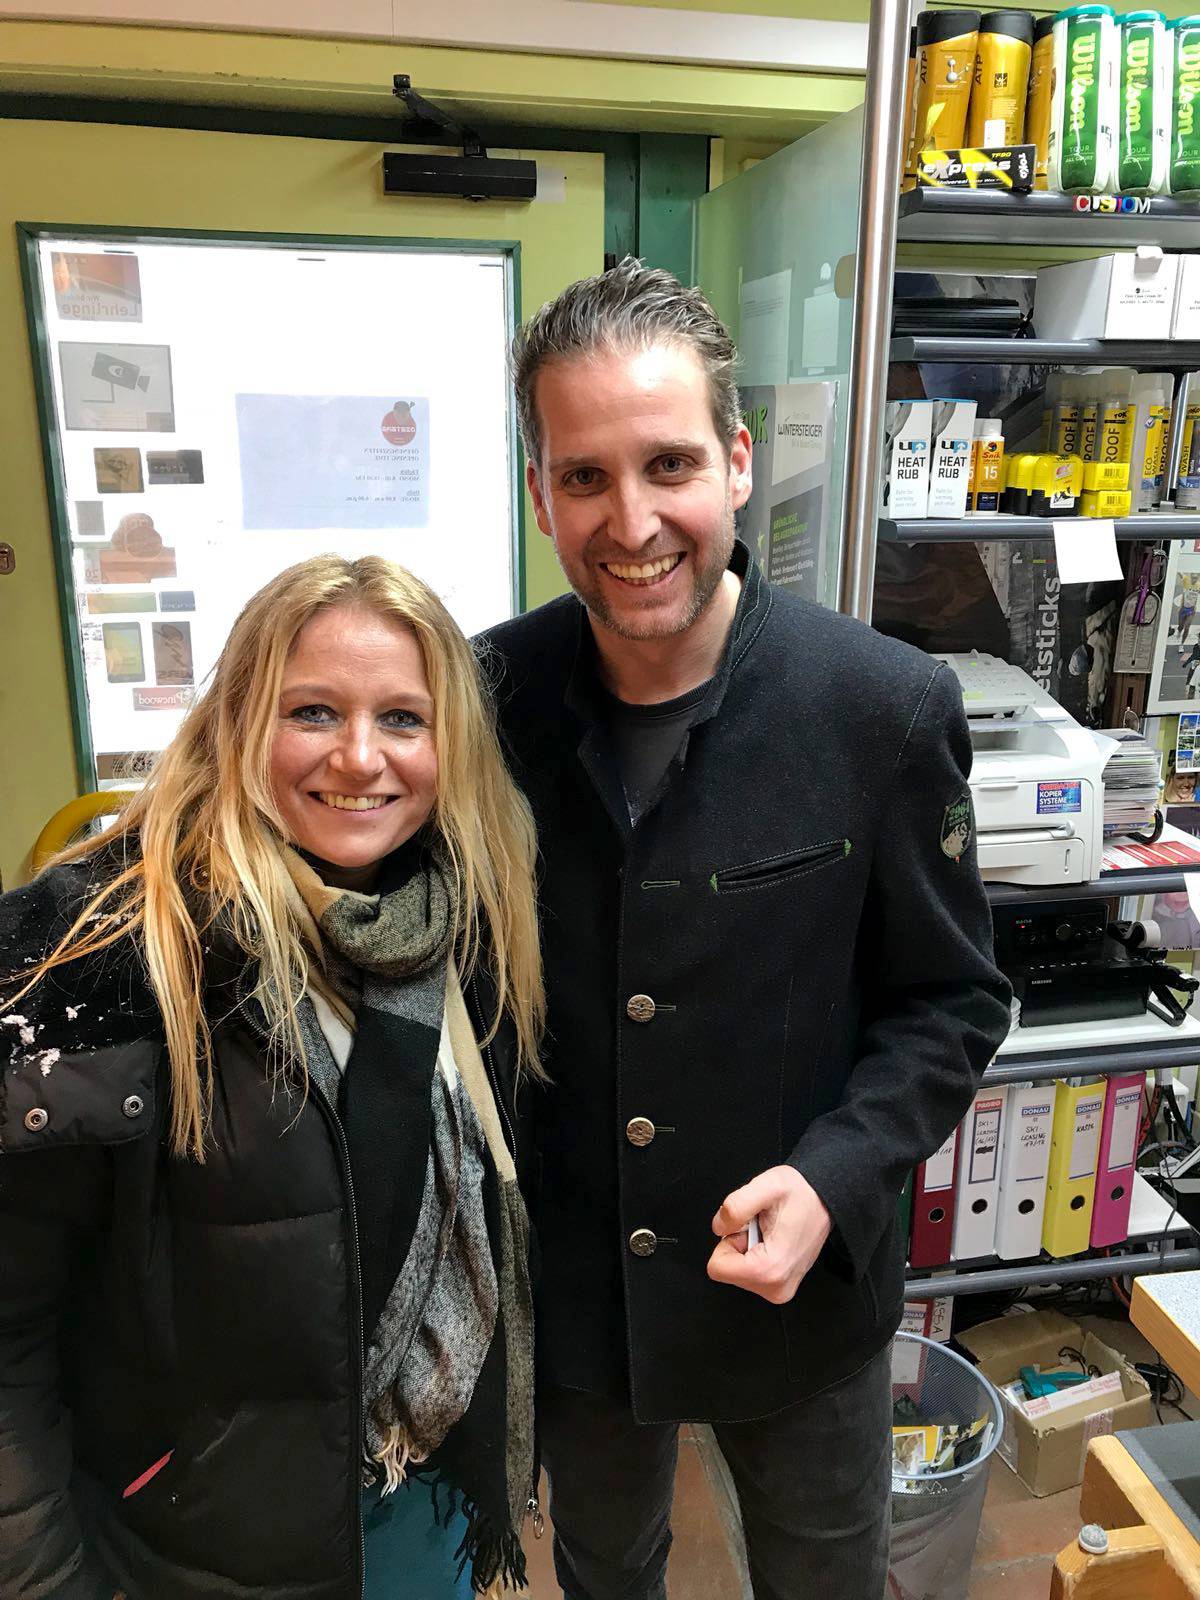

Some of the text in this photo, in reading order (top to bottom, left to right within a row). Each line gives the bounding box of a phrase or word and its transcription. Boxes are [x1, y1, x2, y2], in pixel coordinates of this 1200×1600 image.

[920, 51, 928, 84] ATP
[975, 54, 984, 85] ATP
[1069, 32, 1096, 136] Wilson
[1126, 37, 1150, 132] Wilson
[1127, 146, 1146, 154] OUR
[1018, 153, 1029, 179] TOKO
[1074, 195, 1151, 214] CUSTOM
[778, 423, 823, 438] WINTERSTEIGER
[1105, 428, 1120, 463] ROOF
[898, 457, 926, 468] HEAT
[939, 456, 967, 467] HEAT
[1181, 445, 1189, 473] WASH
[897, 469, 919, 480] RUB
[938, 468, 959, 479] RUB
[984, 466, 998, 480] 15
[1033, 577, 1060, 692] etsticks
[1039, 790, 1062, 798] KOPIER
[1039, 797, 1067, 805] SYSTEME
[1116, 1094, 1140, 1104] DONAU
[1023, 1107, 1049, 1115] DONAU
[1077, 1103, 1101, 1113] DONAU
[1020, 1133, 1046, 1141] LEASING
[933, 1299, 947, 1334] ASSA
